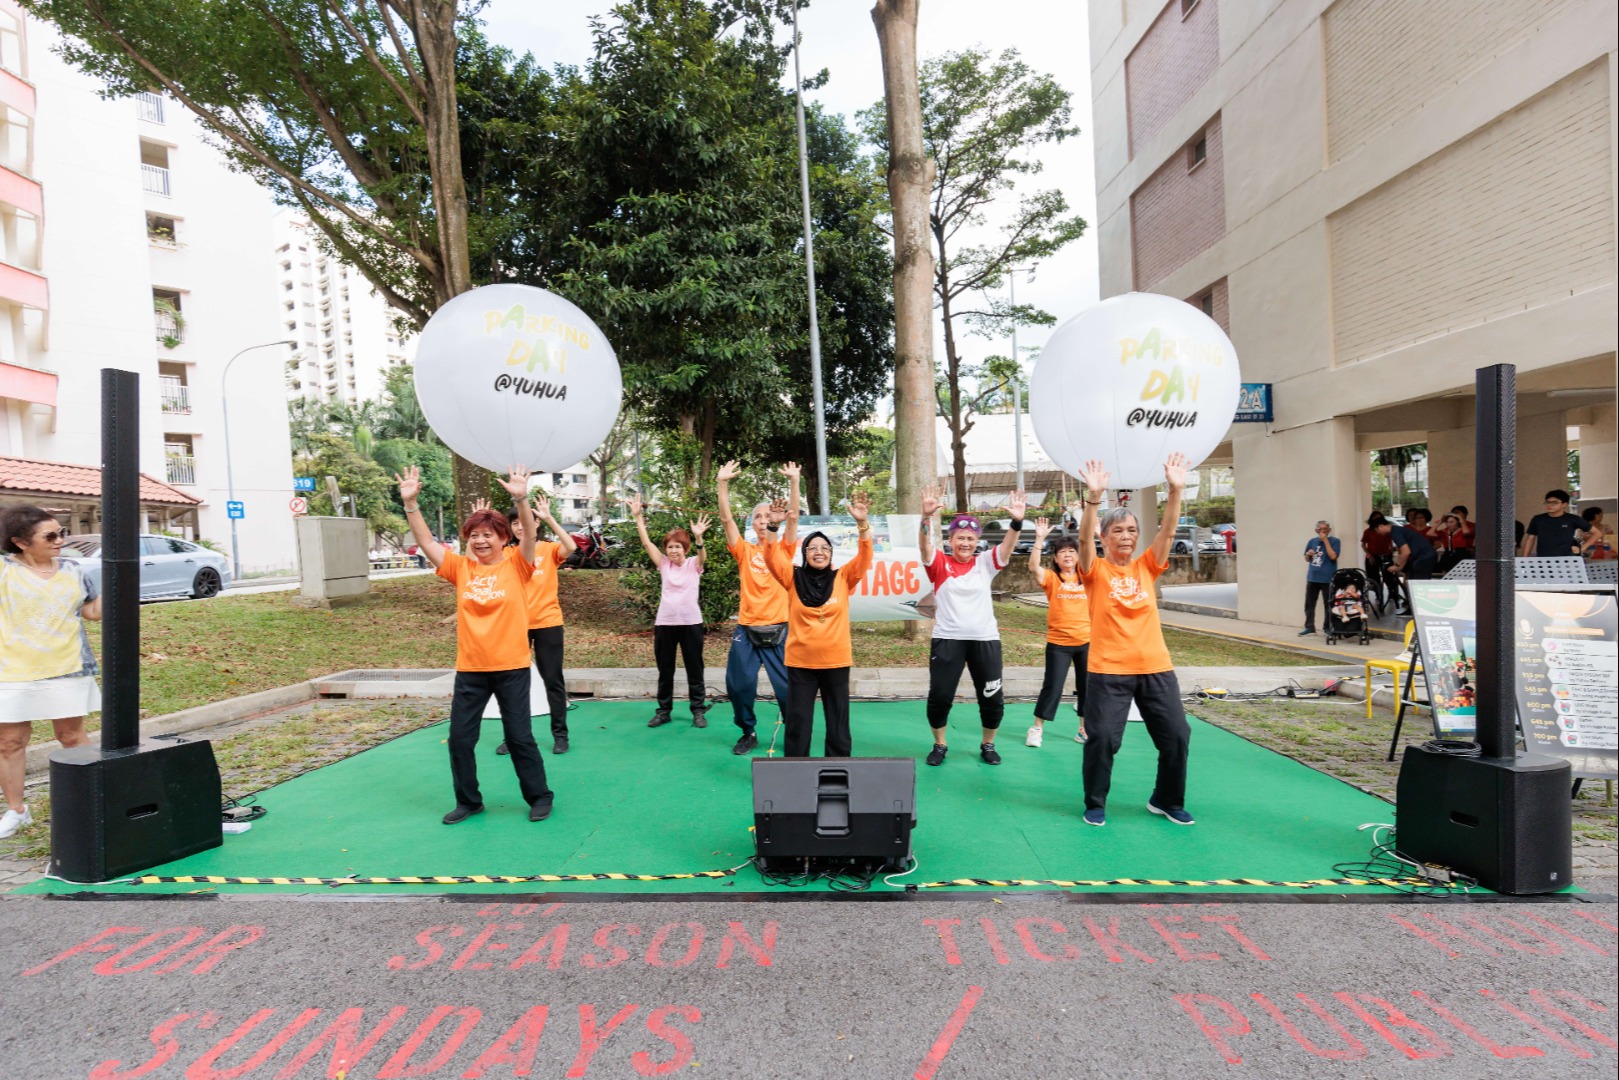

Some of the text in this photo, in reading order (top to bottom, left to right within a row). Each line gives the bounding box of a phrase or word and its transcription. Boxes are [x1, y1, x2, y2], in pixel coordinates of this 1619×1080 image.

[484, 303, 590, 352] PARKING
[506, 338, 568, 374] DAY
[494, 373, 567, 401] @YUHUA
[1140, 366, 1199, 405] DAY
[1127, 408, 1197, 429] @YUHUA
[849, 561, 920, 597] TAGE
[20, 925, 266, 976] FOR
[388, 920, 779, 971] SEASON
[923, 917, 1272, 965] TICKET
[88, 1005, 704, 1080] SUNDAYS
